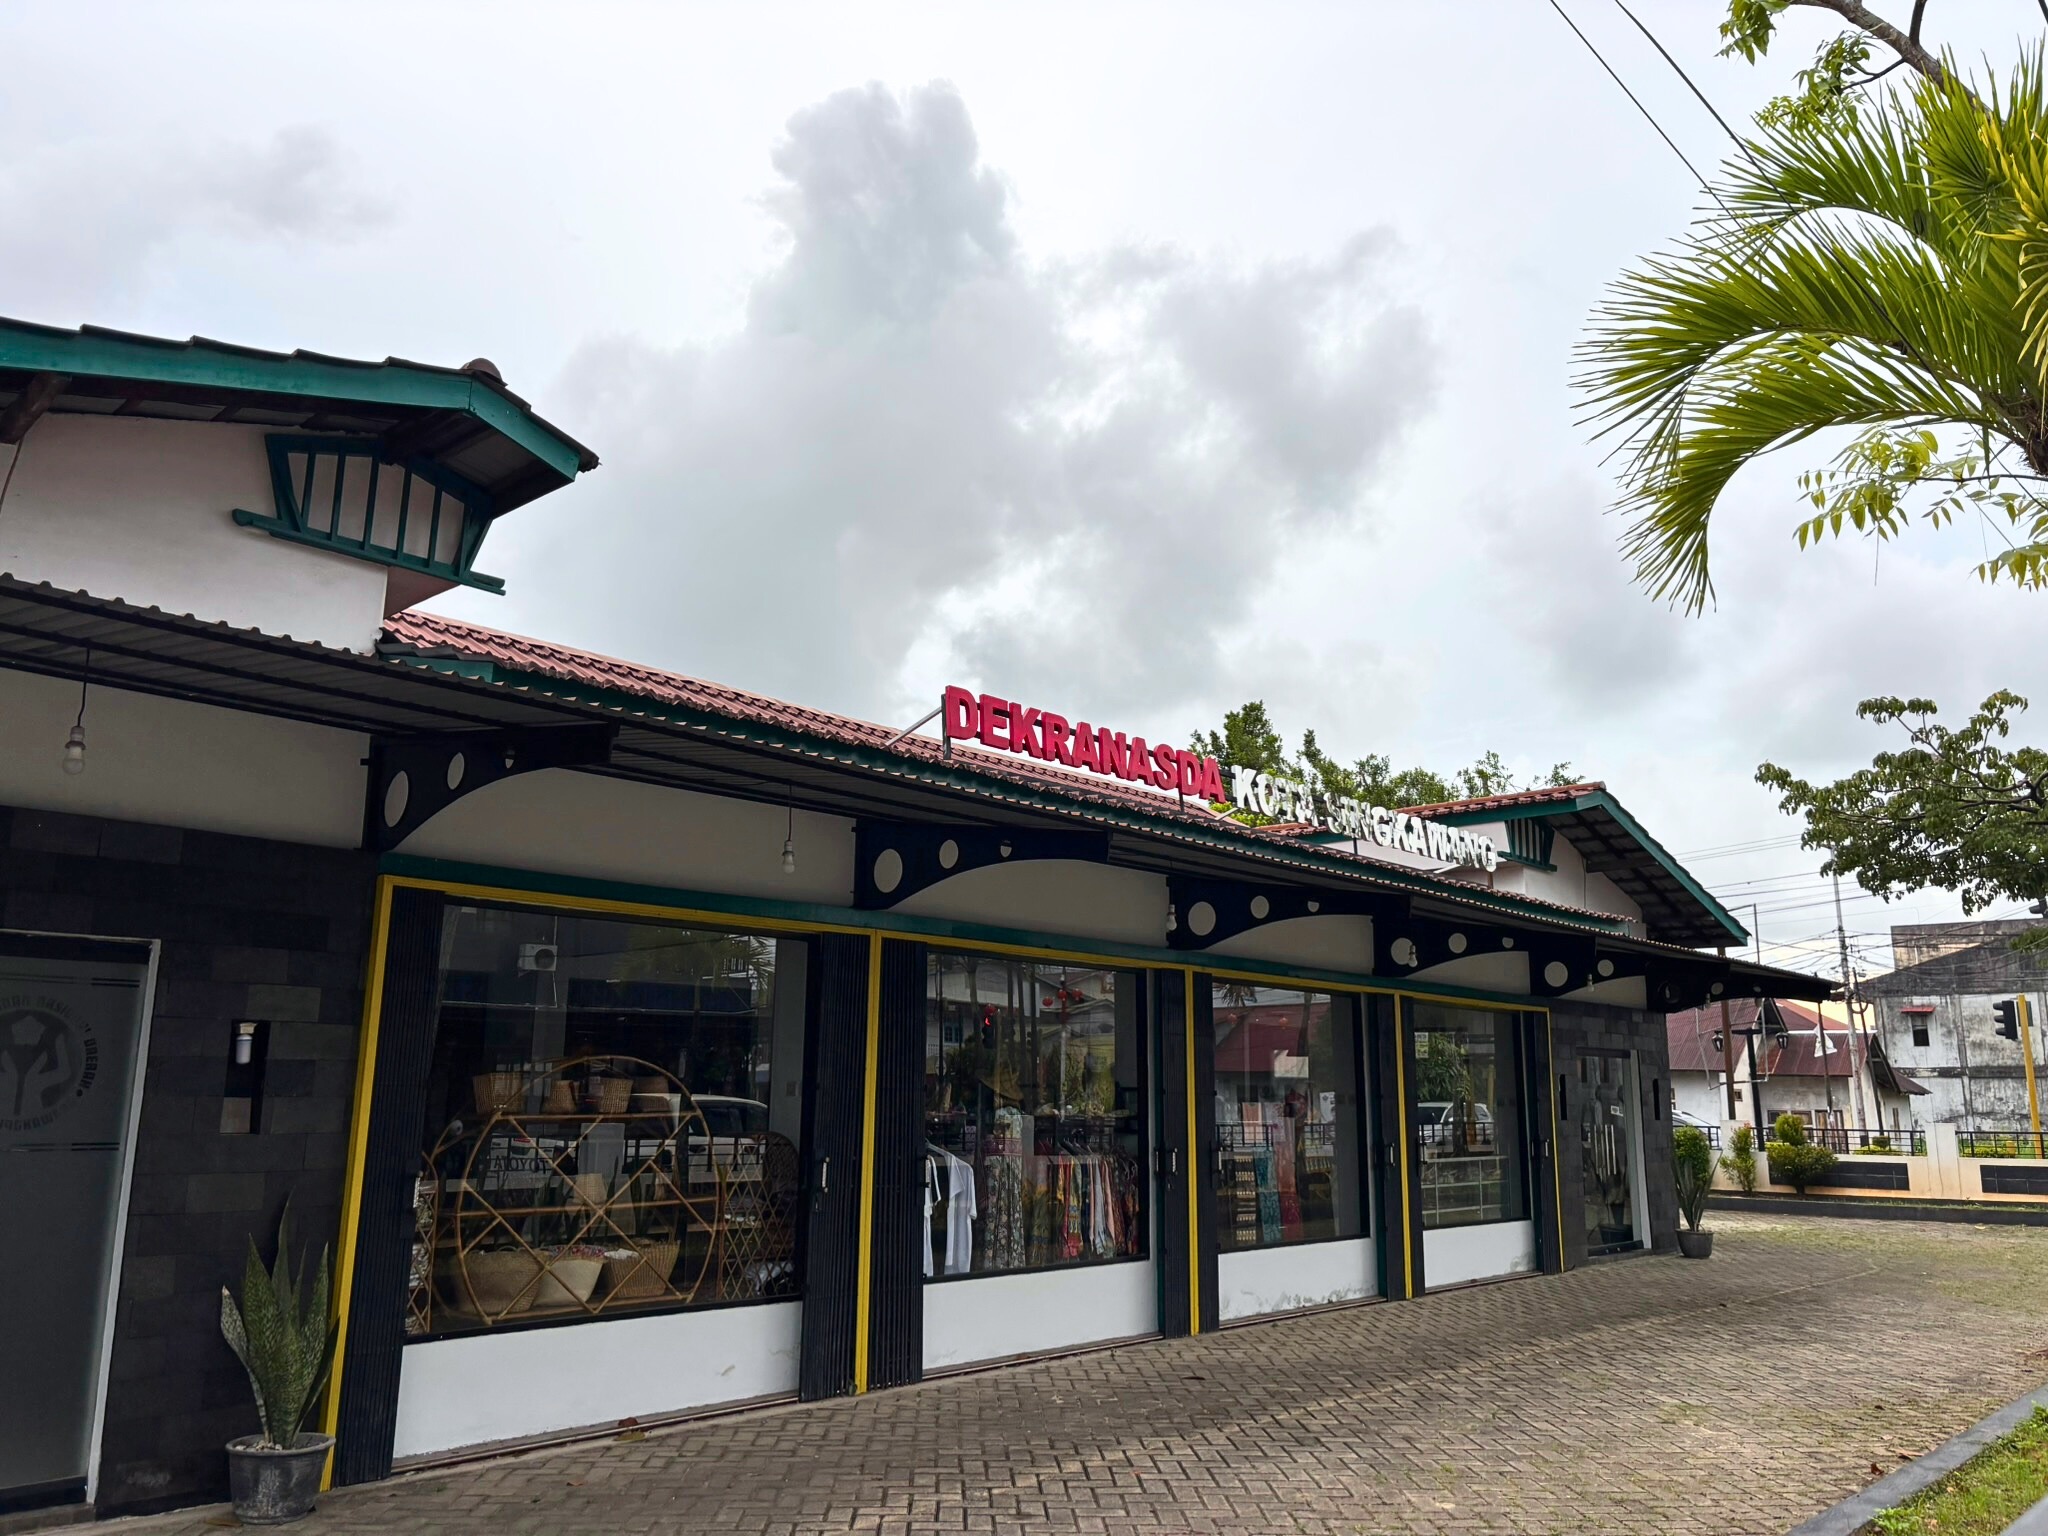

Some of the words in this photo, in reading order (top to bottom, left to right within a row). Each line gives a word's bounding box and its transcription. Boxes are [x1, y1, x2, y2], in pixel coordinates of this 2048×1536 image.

[945, 685, 1226, 803] DEKRANASDA
[1231, 765, 1319, 827] KOTA
[1323, 792, 1497, 872] SINGKAWANG
